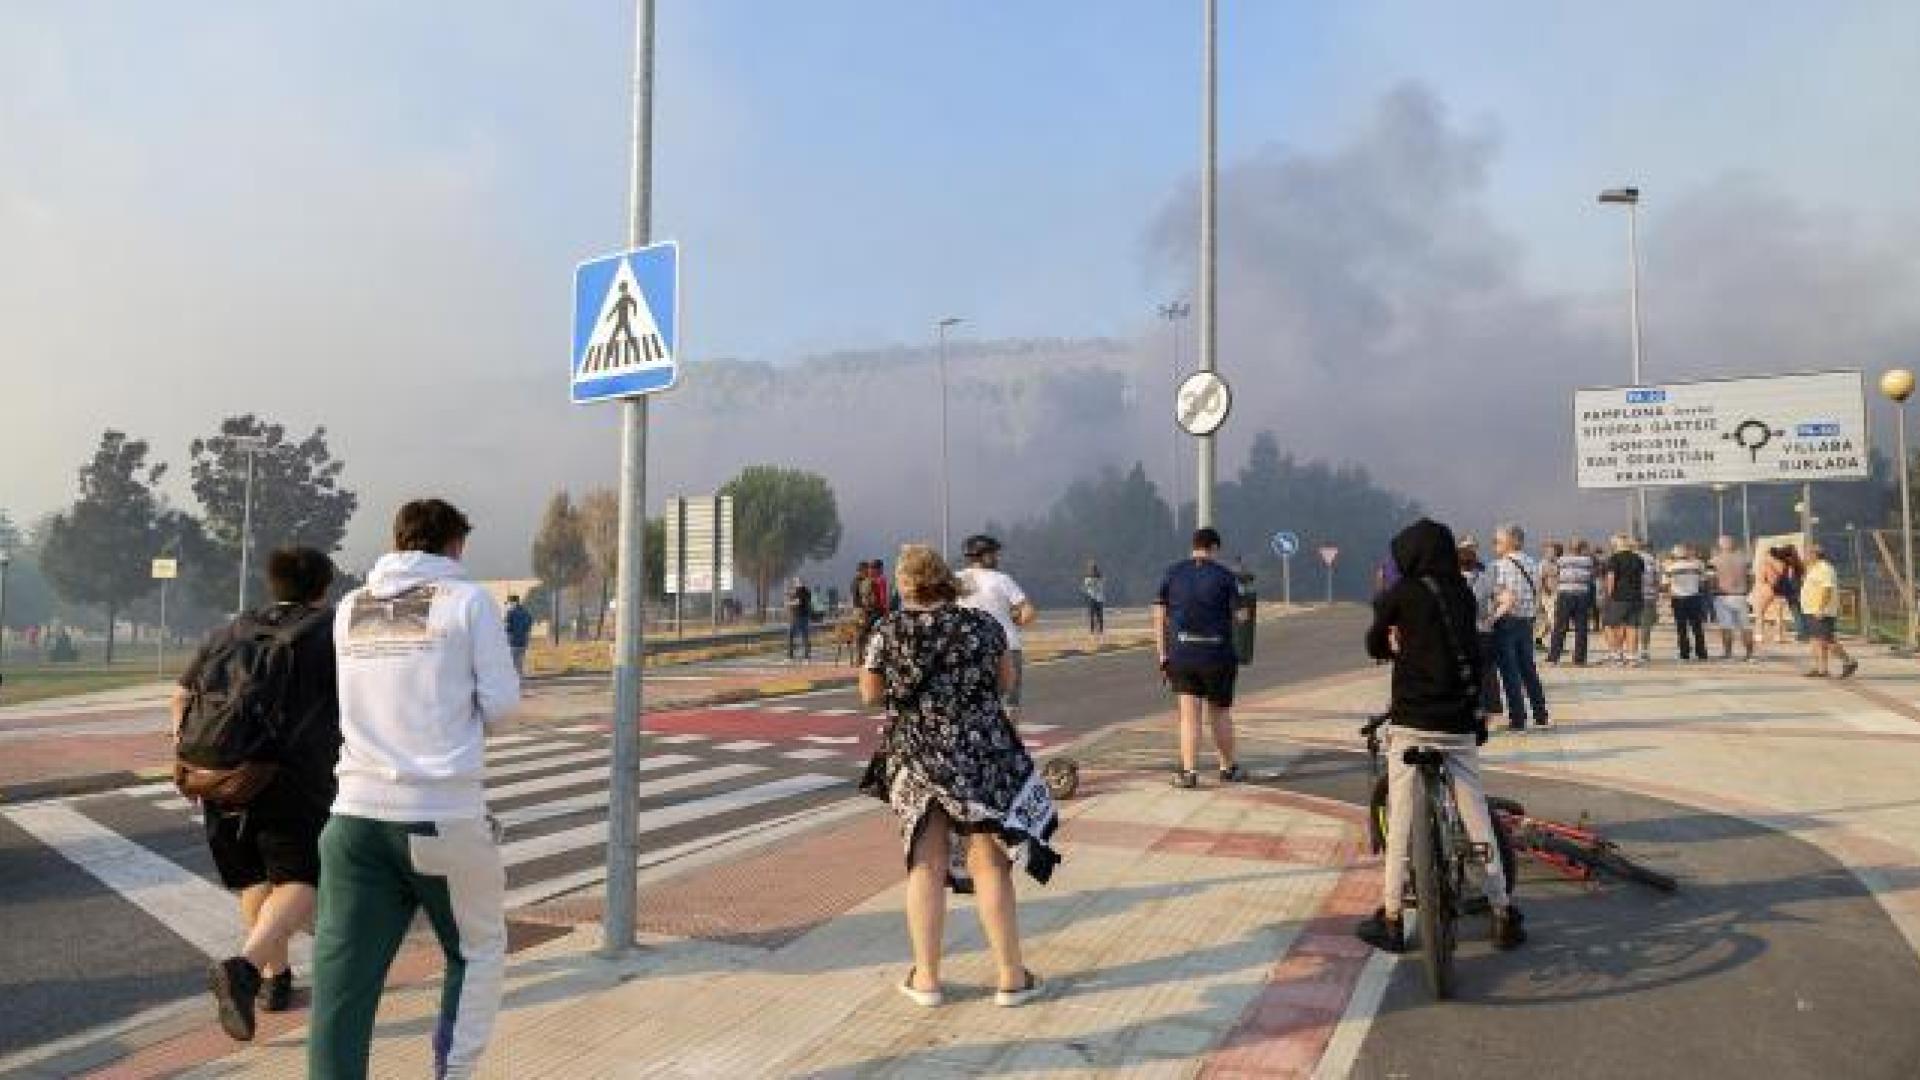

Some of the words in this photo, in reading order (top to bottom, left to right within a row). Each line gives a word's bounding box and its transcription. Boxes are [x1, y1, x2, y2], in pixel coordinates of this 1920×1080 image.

[1583, 406, 1663, 421] PAMPLONA
[1779, 456, 1859, 472] BURLADA
[1616, 468, 1686, 481] FRANCIA
